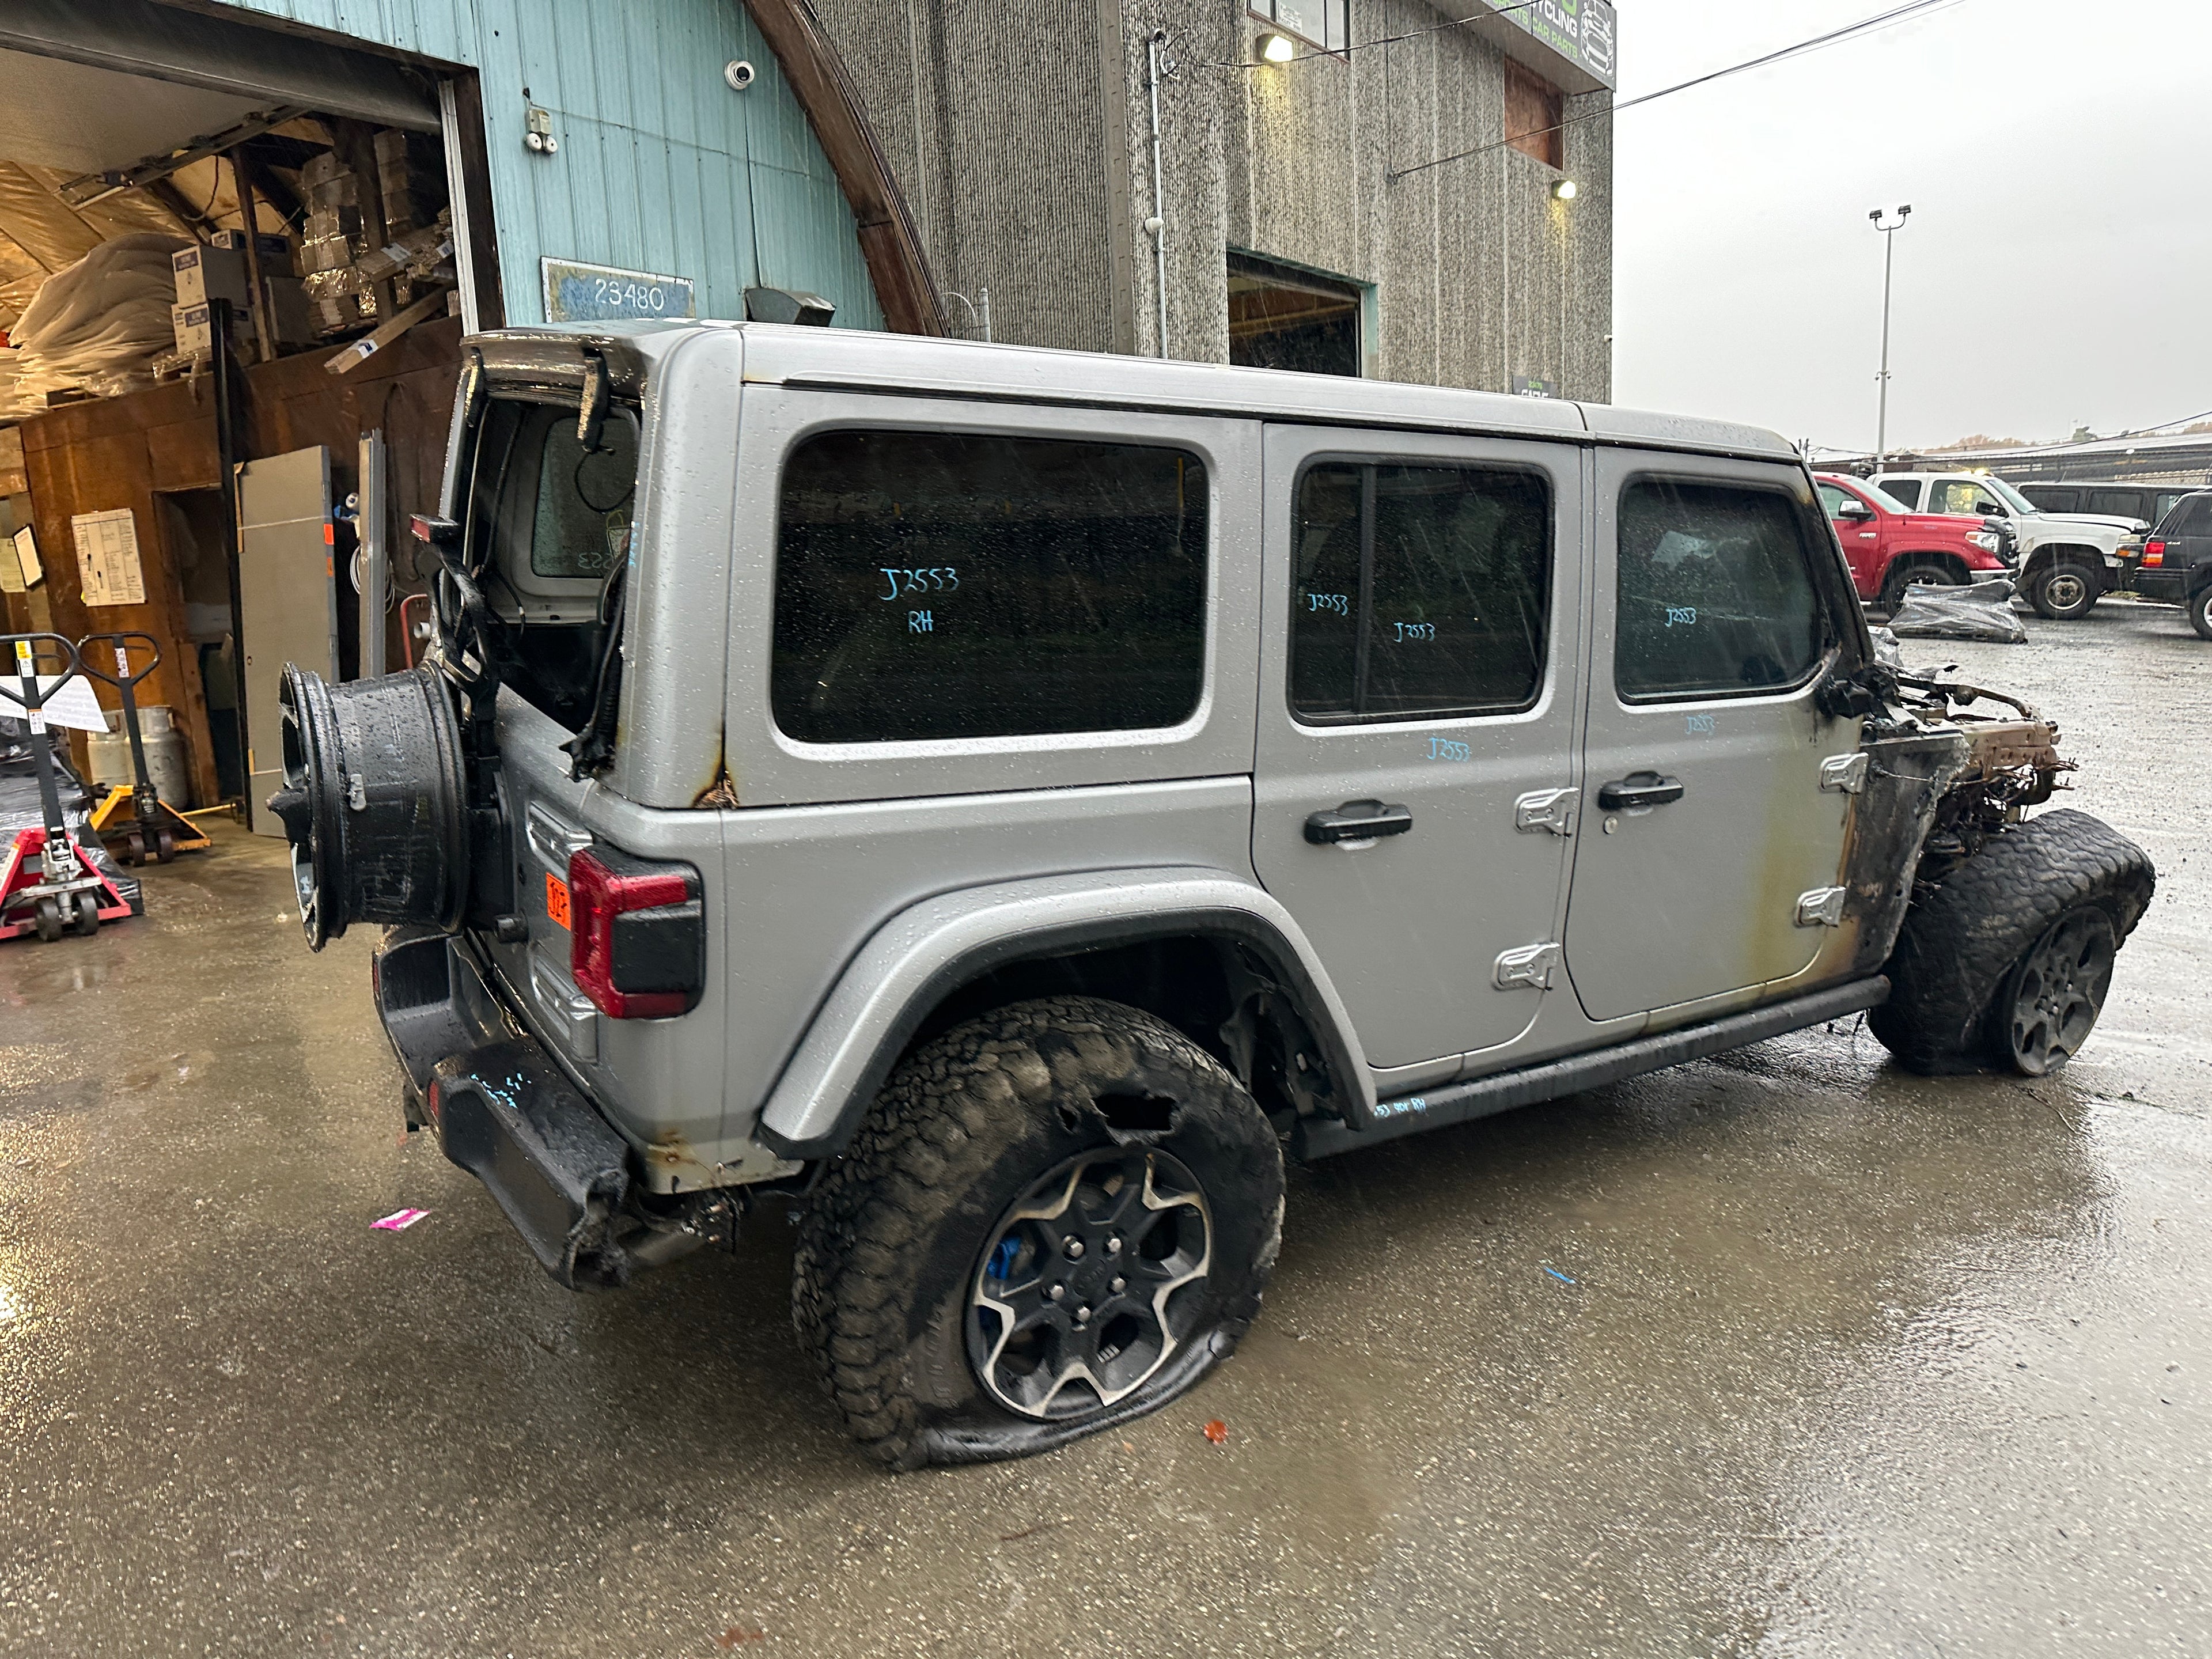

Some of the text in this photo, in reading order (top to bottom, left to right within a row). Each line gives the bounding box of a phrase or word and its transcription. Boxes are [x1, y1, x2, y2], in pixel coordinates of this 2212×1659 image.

[1524, 0, 1577, 38] YCLING
[1533, 16, 1549, 40] CAR
[1552, 31, 1577, 59] PARTS
[596, 279, 664, 310] 23480
[877, 567, 959, 600] J2553
[1306, 593, 1348, 616] J2553
[908, 609, 933, 633] RH
[1665, 607, 1696, 627] J2553
[1393, 622, 1435, 643] J2553
[1685, 714, 1714, 735] J2553
[1426, 737, 1470, 762] J2553
